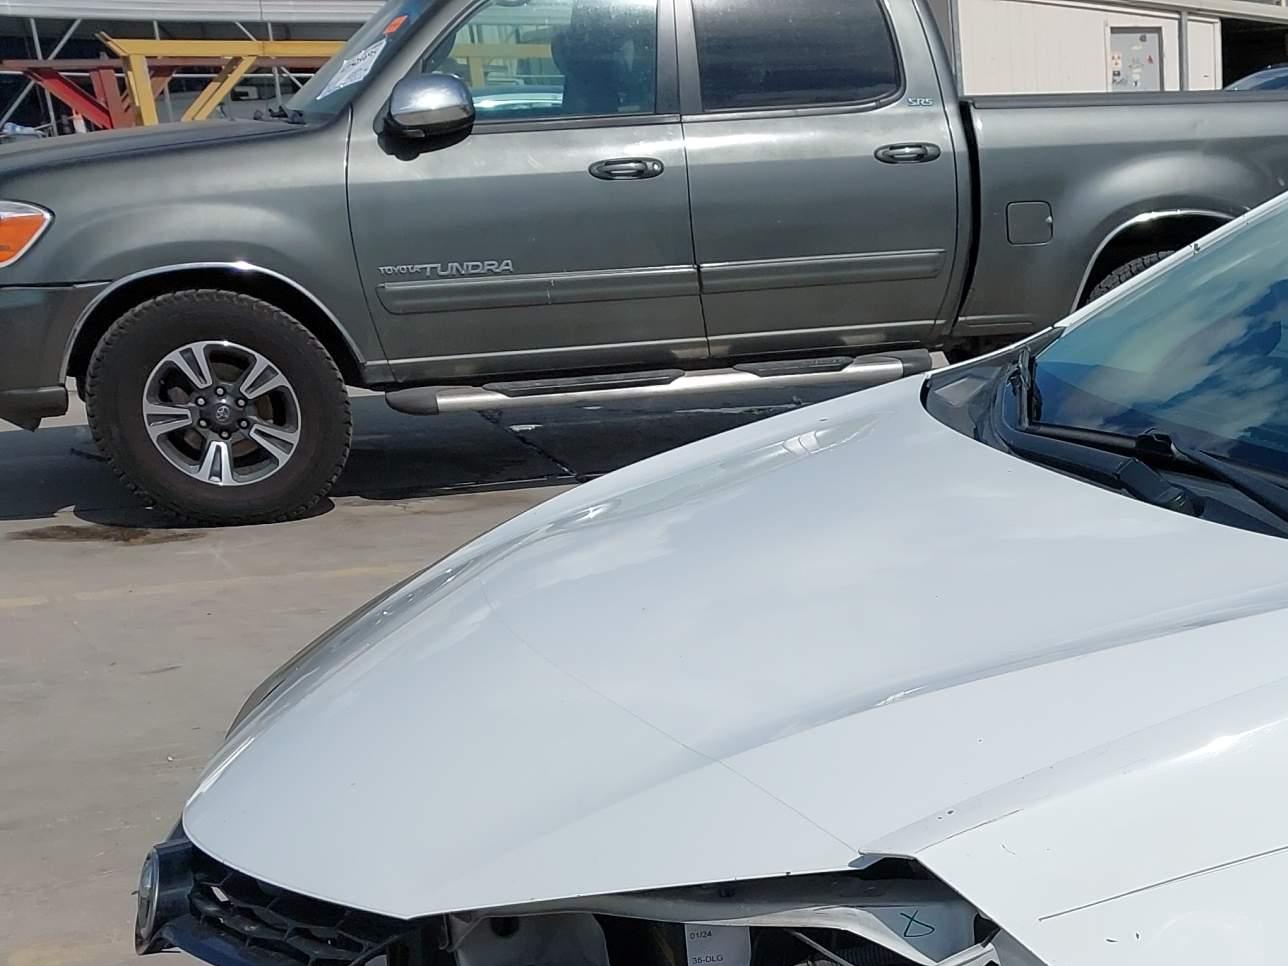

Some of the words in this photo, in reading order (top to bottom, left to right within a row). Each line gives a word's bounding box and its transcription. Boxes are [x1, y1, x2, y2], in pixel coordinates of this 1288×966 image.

[908, 97, 933, 106] SR5
[379, 264, 420, 275] TOYOTA
[415, 260, 514, 276] TUNDRA
